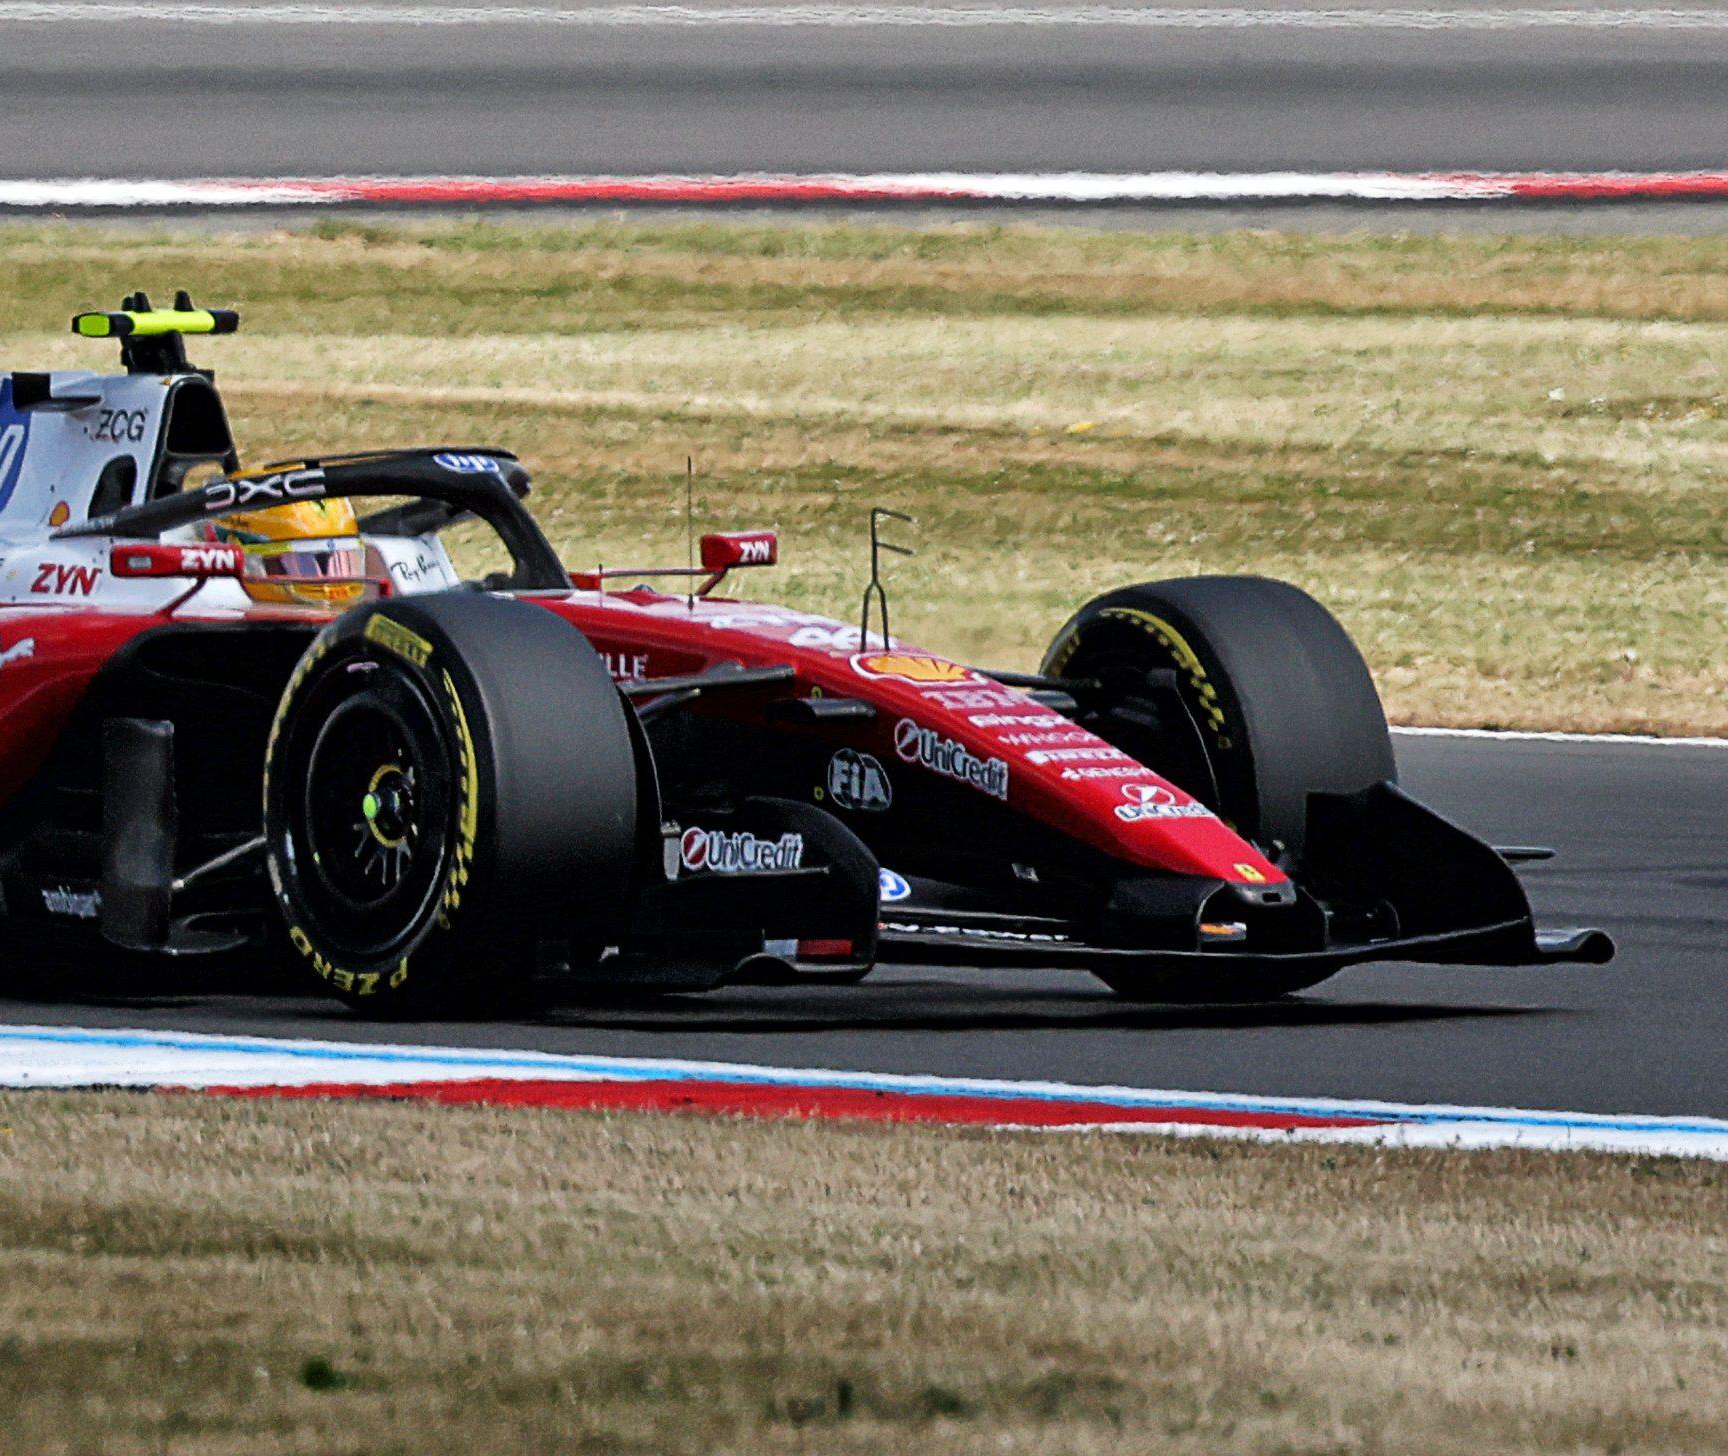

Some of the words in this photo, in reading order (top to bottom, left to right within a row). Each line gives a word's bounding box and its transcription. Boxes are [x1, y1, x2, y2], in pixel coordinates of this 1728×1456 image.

[181, 550, 235, 569] ZYN
[31, 563, 100, 596] ZYN
[919, 727, 1008, 800] UniCredit
[833, 763, 886, 805] FIA
[707, 834, 803, 871] UniCredit
